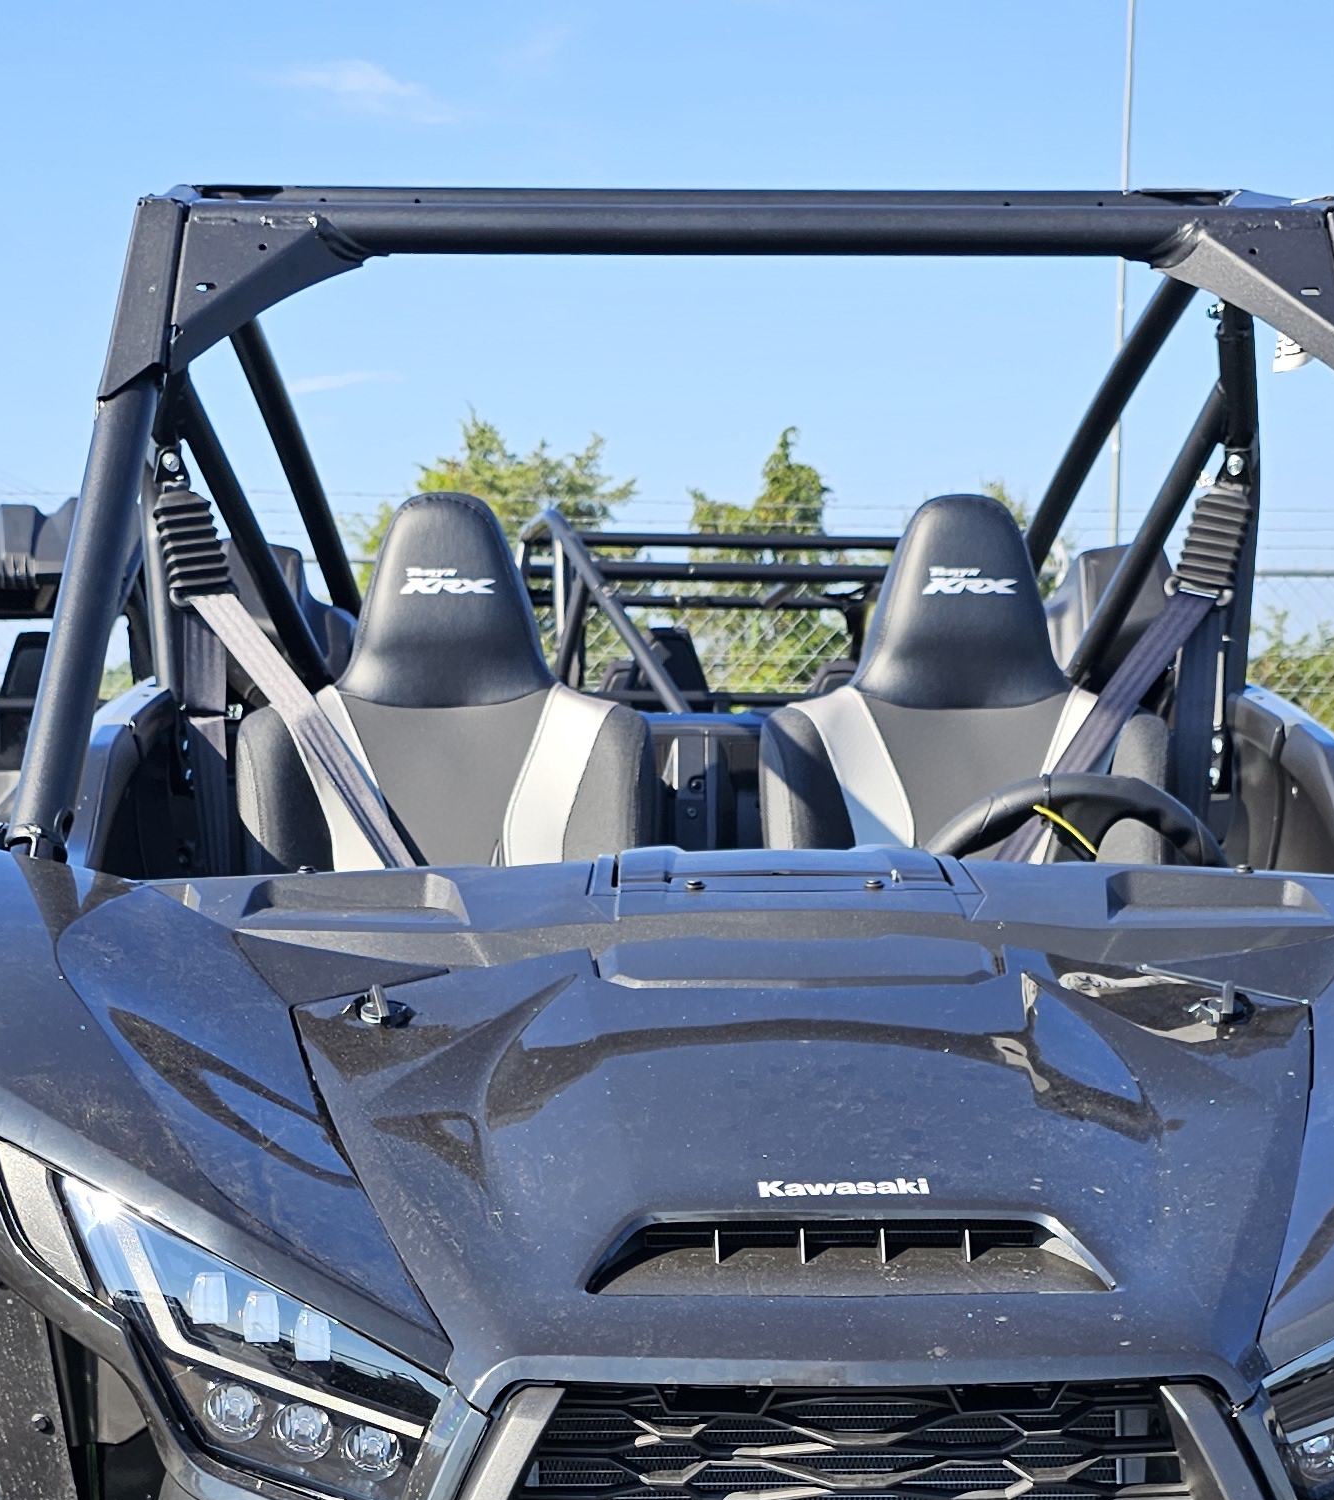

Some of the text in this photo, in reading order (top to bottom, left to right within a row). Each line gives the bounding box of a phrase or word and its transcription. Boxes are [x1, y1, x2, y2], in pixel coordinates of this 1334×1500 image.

[399, 577, 496, 595] KRX
[921, 577, 1018, 595] KRX
[757, 1177, 930, 1198] Kawasaki
